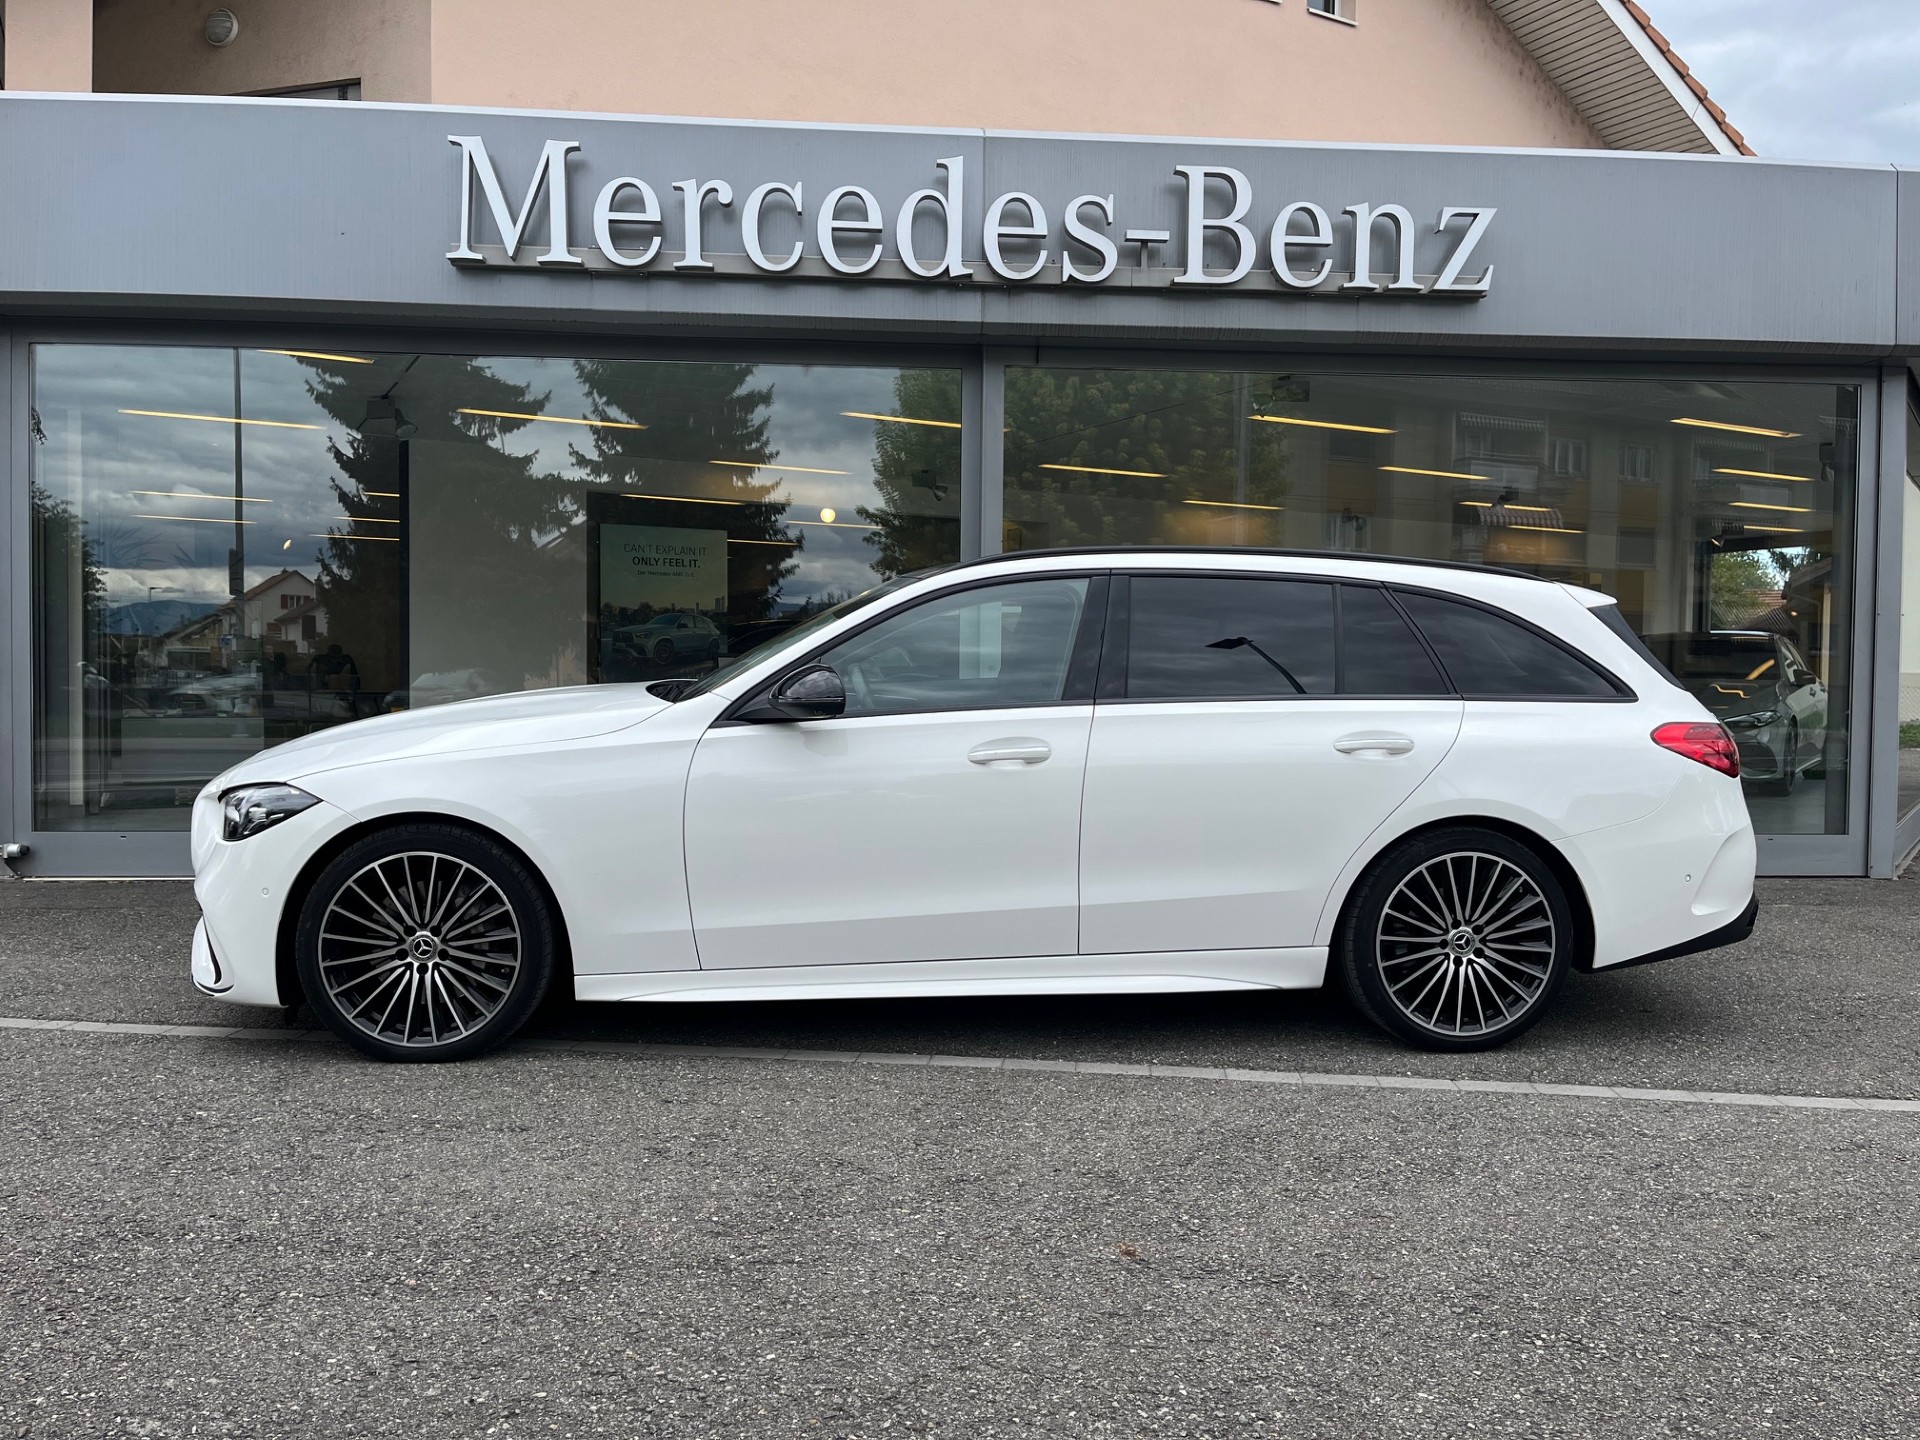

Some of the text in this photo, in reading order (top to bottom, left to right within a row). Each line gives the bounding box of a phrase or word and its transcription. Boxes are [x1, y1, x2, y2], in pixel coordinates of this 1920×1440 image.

[445, 134, 1499, 297] Mercedes-Benz
[623, 543, 653, 553] CAN'T
[655, 544, 696, 556] EXPLAIN
[632, 556, 701, 569] ONLY FEEL IT.
